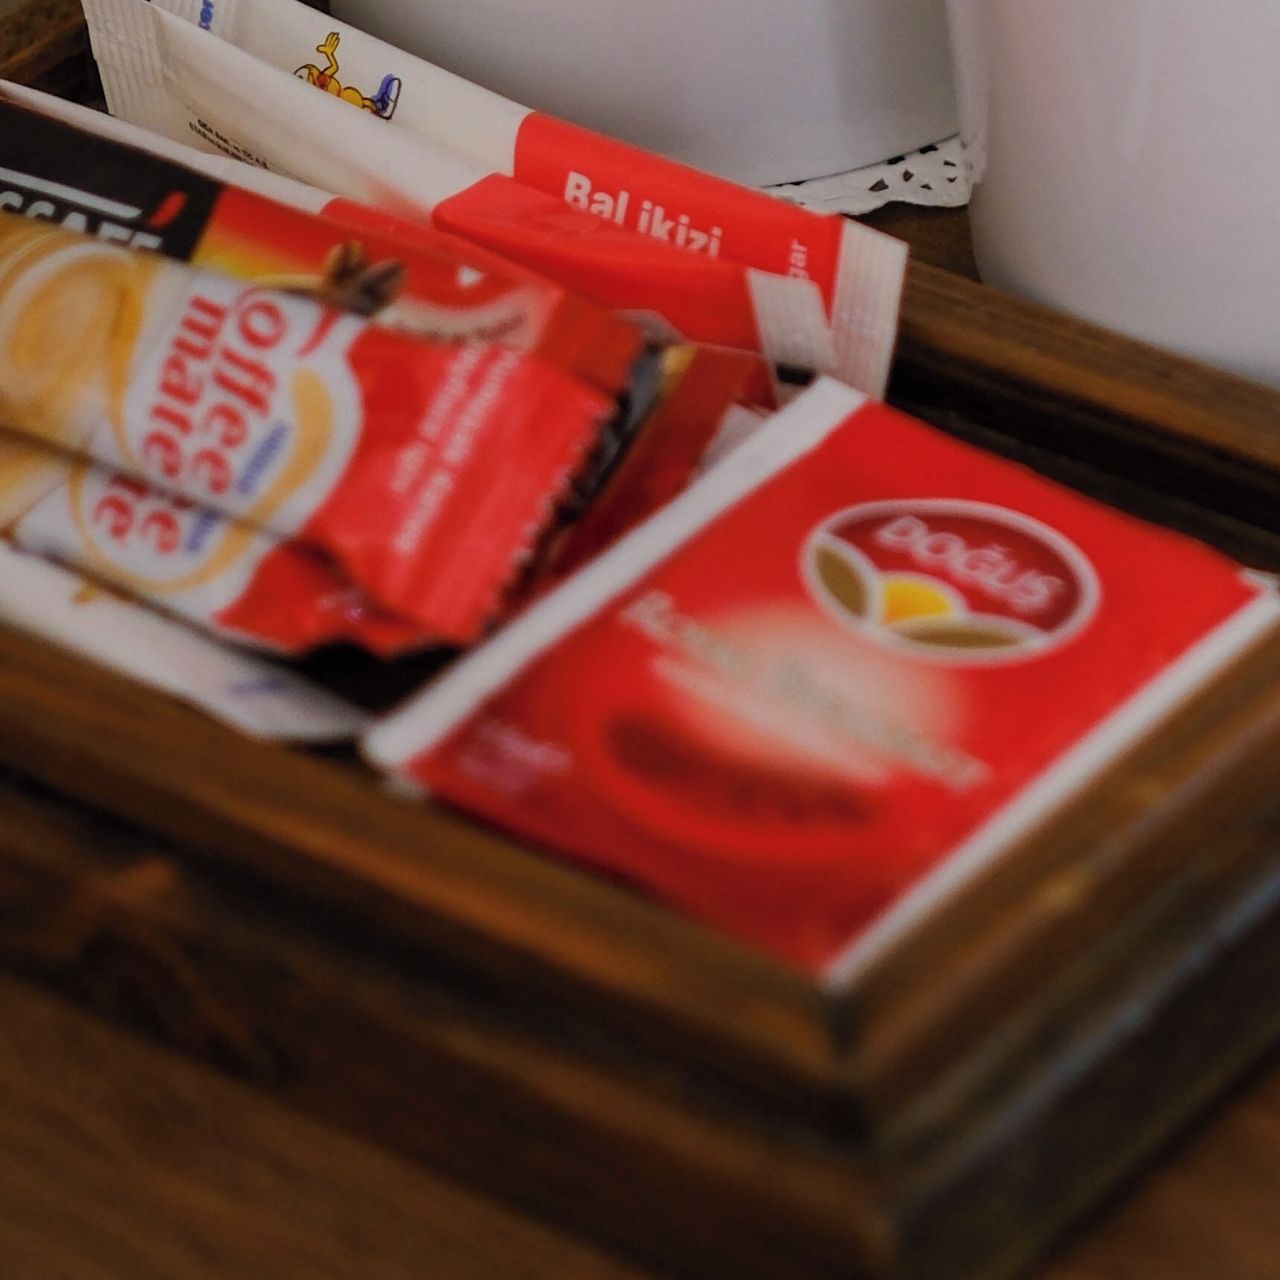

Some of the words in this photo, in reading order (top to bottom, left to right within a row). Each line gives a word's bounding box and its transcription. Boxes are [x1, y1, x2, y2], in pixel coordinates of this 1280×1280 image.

[564, 171, 629, 225] Bal
[637, 200, 722, 258] ikizi
[142, 295, 228, 480] mate
